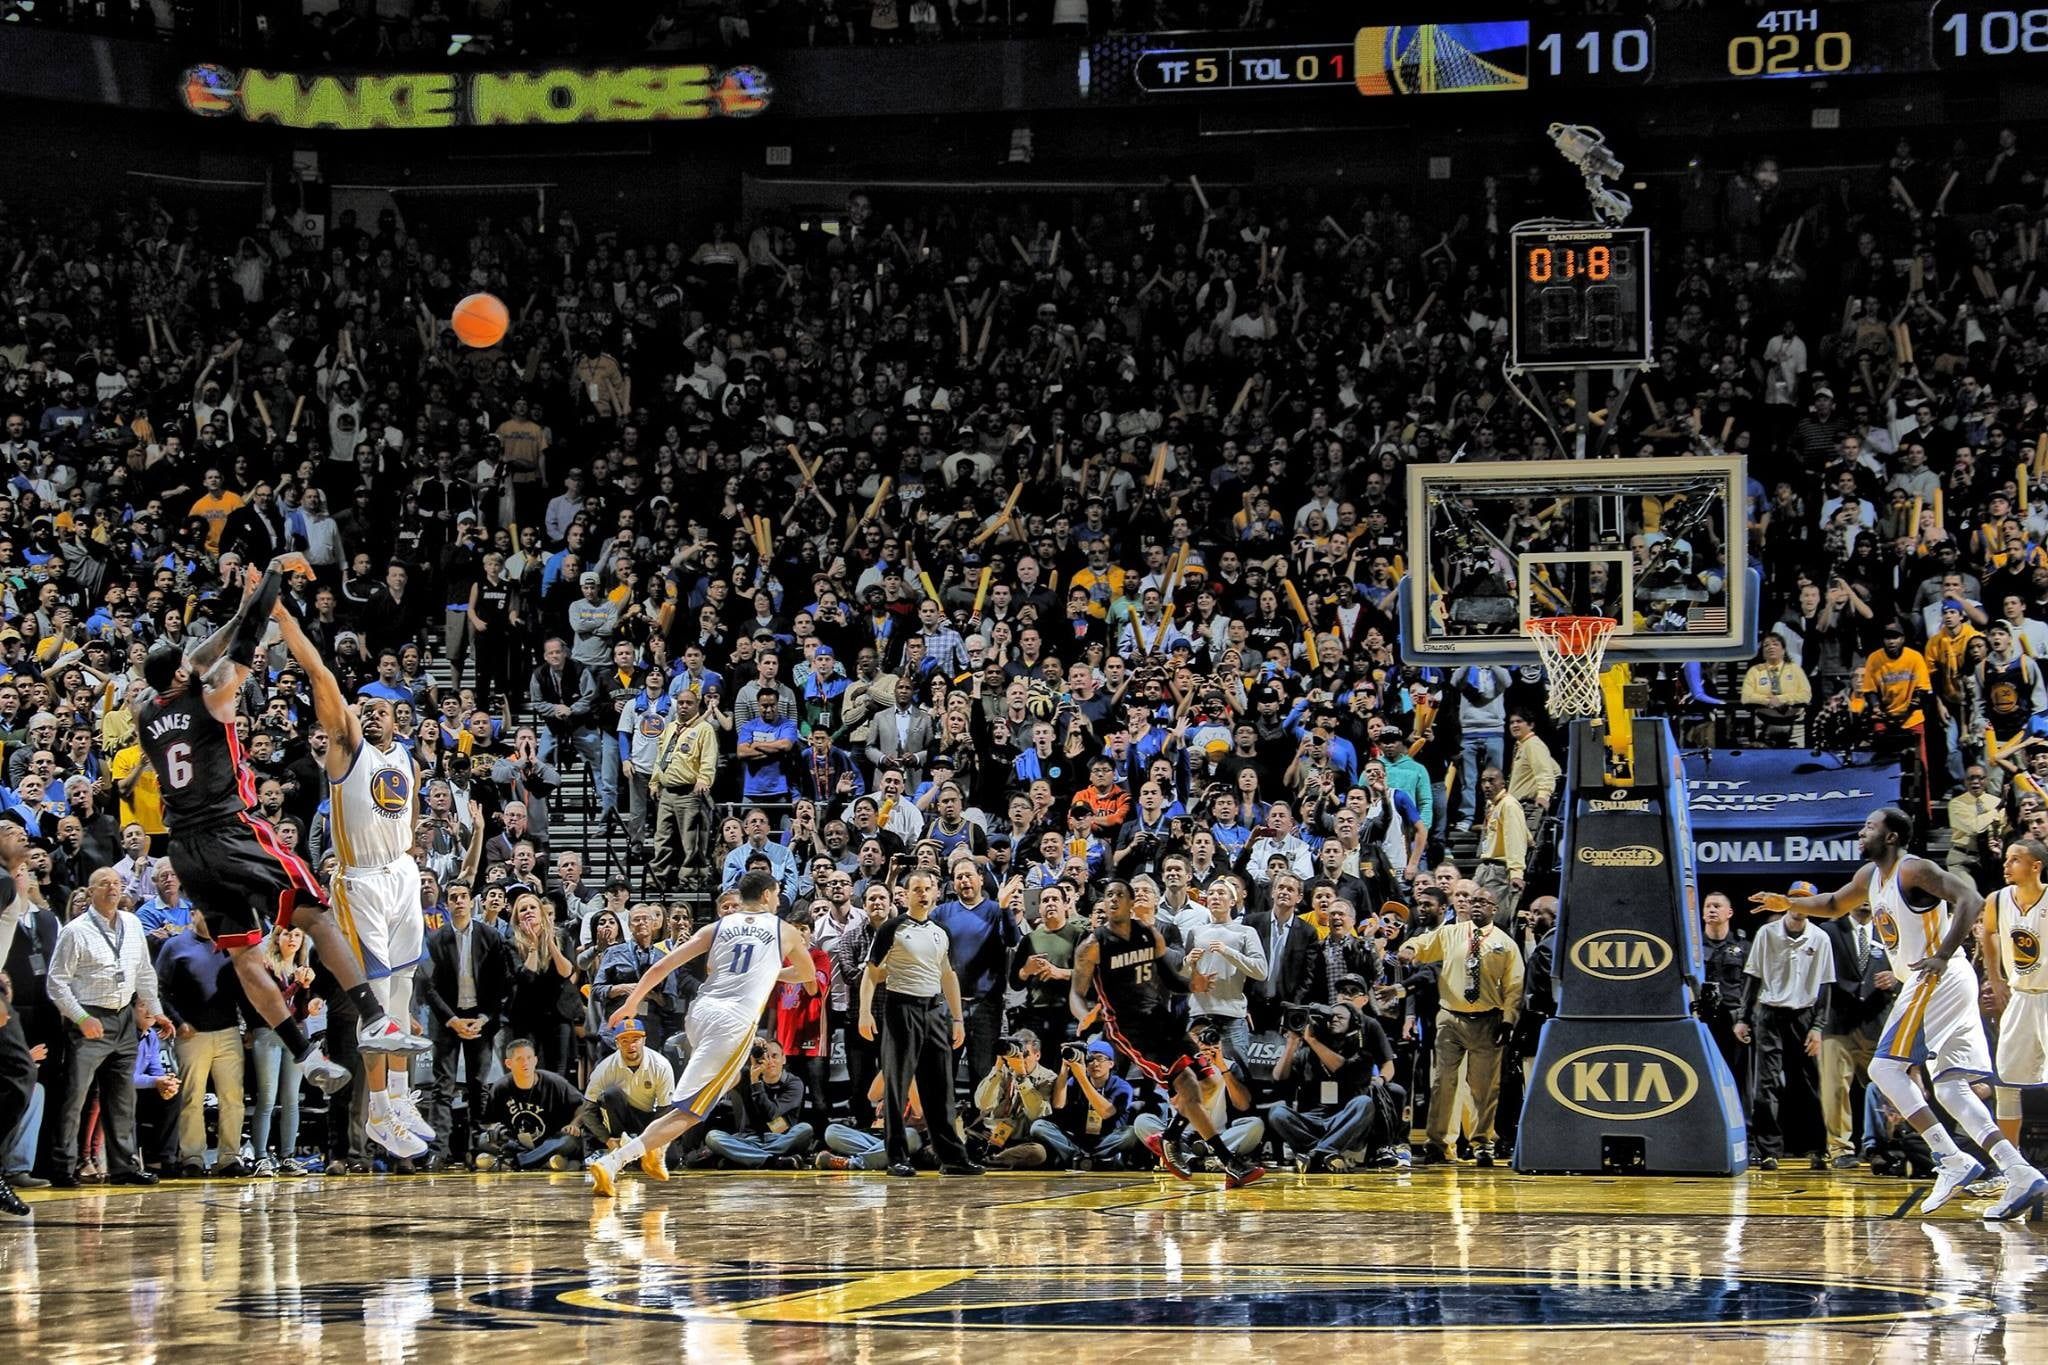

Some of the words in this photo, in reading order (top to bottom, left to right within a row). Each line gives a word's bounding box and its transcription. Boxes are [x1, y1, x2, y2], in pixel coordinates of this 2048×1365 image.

[1757, 9, 1817, 31] 4TH
[1942, 9, 2048, 56] 108
[1538, 30, 1648, 75] 110
[1728, 32, 1851, 76] 02.0
[1157, 61, 1190, 83] TF
[1195, 58, 1218, 82] 5
[1240, 58, 1290, 81] TOL
[1296, 56, 1319, 80] 0
[1330, 55, 1344, 78] 1
[242, 68, 455, 129] MAKE
[470, 64, 711, 124] NOISE
[1547, 232, 1613, 241] DAKTRONICS
[1528, 246, 1611, 282] 01.8
[146, 713, 191, 740] JAMES
[167, 742, 193, 789] 6
[391, 775, 400, 788] 9
[1688, 779, 1750, 790] ITY
[1589, 799, 1650, 813] SPALDING
[1688, 790, 1874, 803] ATIONAL
[719, 926, 776, 946] THOMPSON
[2018, 936, 2033, 947] 30
[729, 943, 755, 974] 11
[1110, 947, 1154, 970] MIAMI
[1588, 941, 1656, 968] KIA
[1135, 962, 1152, 985] 15
[1572, 1062, 1675, 1103] KIA
